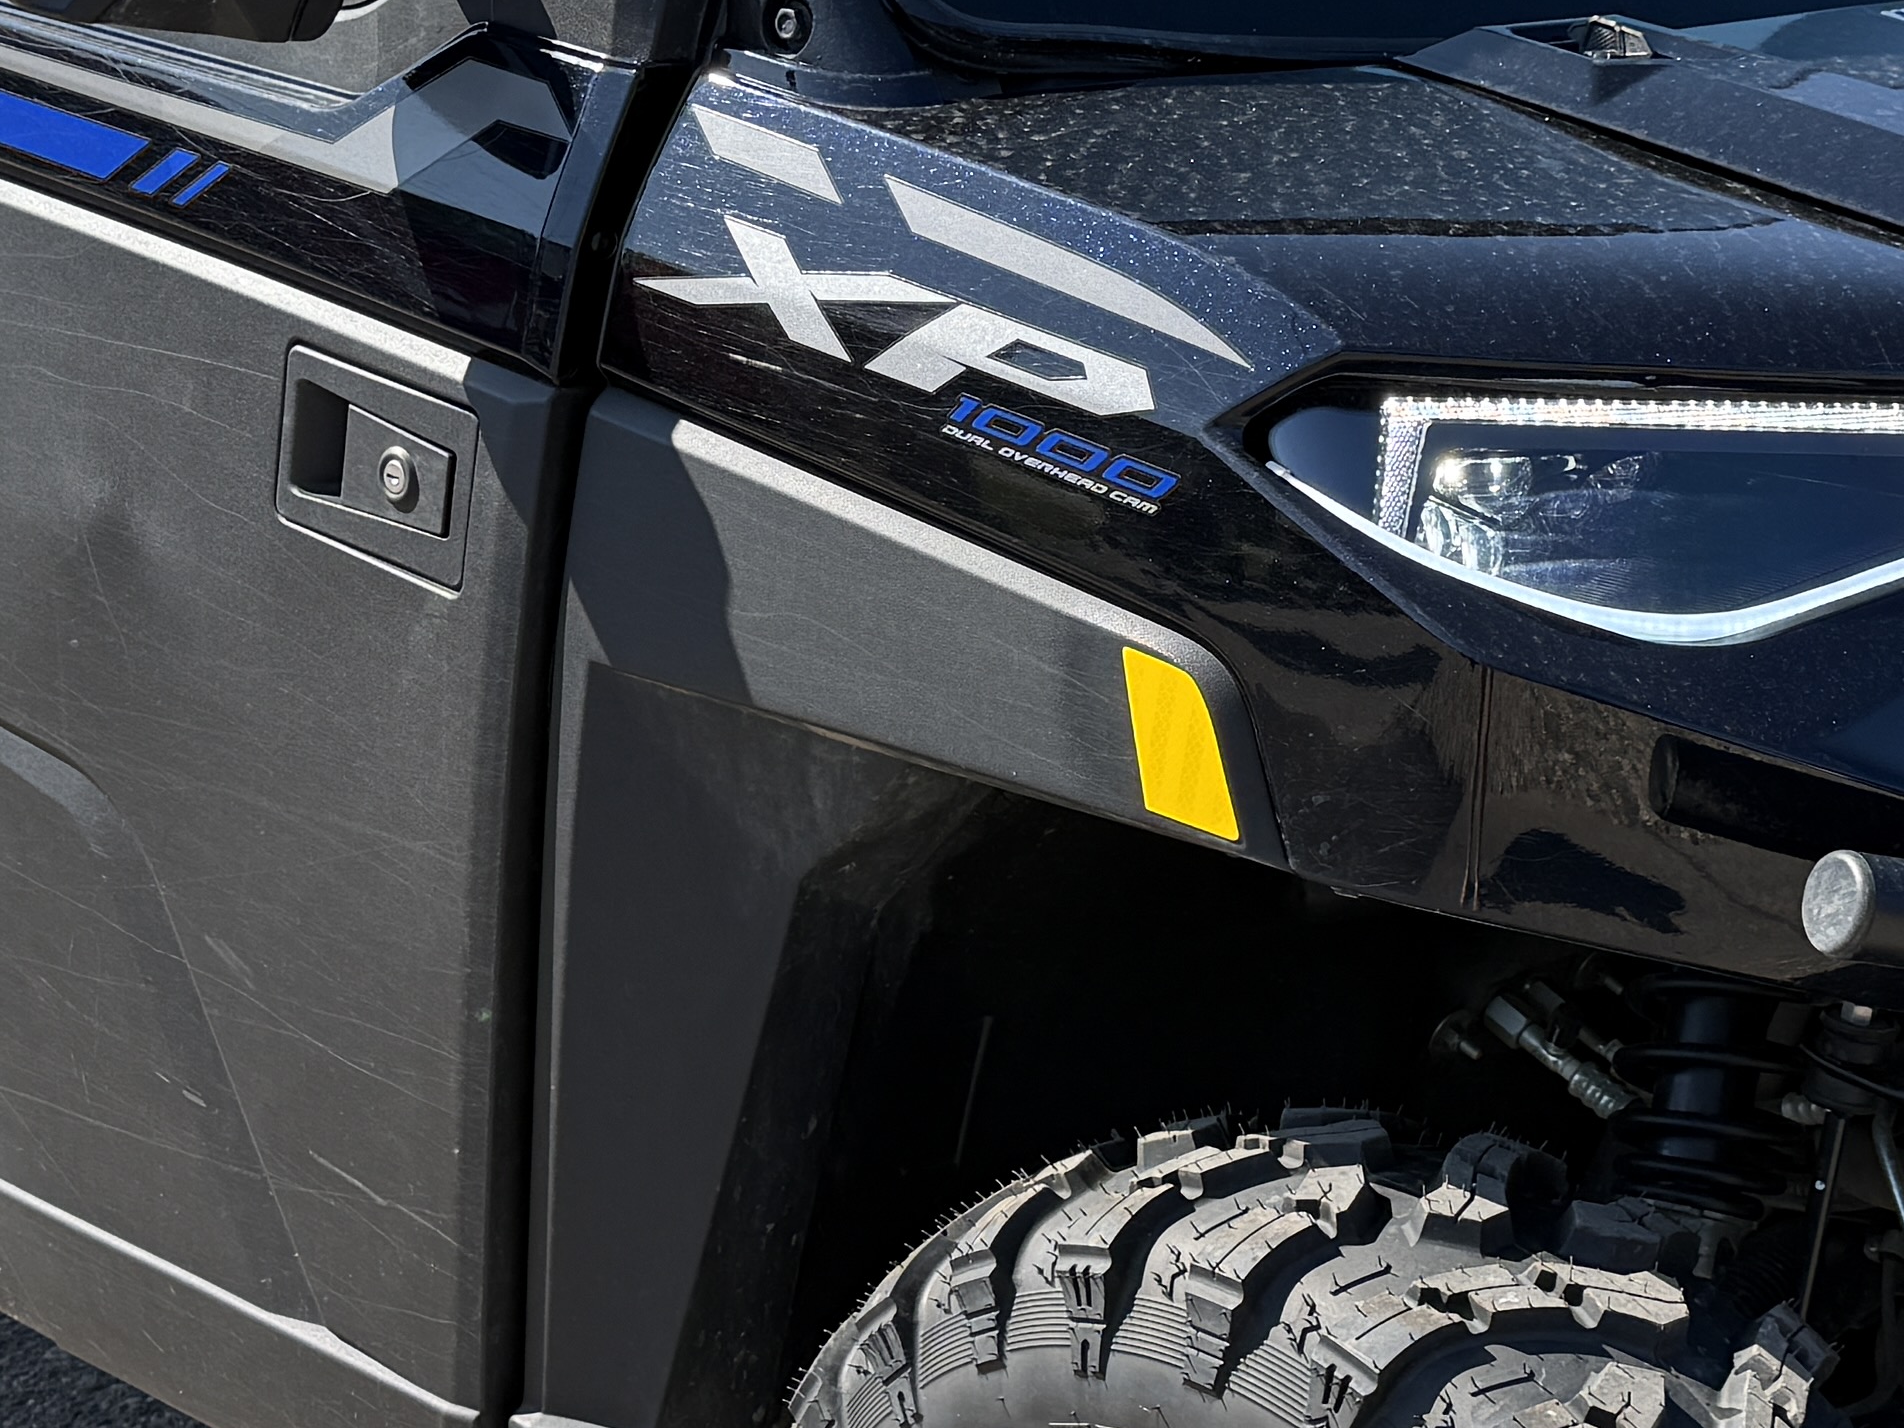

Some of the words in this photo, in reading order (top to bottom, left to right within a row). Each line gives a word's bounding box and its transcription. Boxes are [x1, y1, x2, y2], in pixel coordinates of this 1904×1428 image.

[632, 214, 1157, 417] XP
[941, 424, 994, 451] DUAL
[998, 446, 1108, 495] OVERHEAD
[1109, 491, 1161, 515] CAM
[949, 392, 1182, 500] 1000
